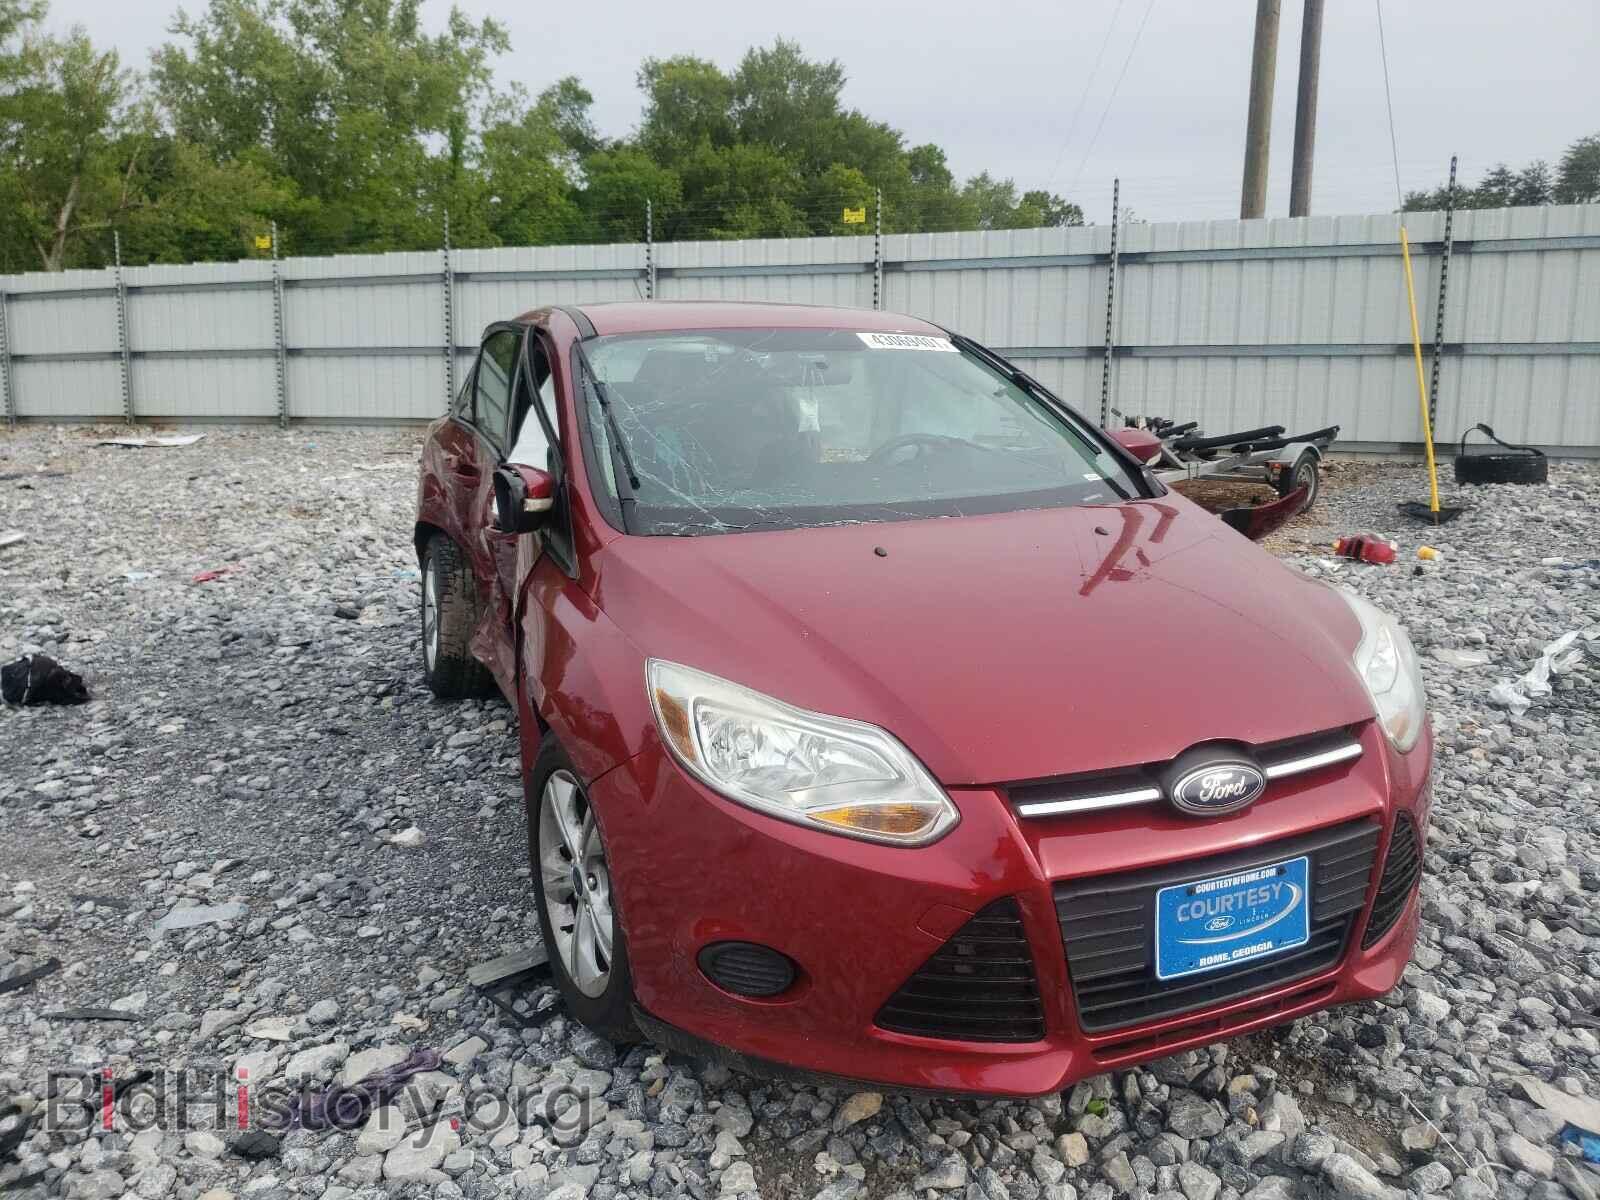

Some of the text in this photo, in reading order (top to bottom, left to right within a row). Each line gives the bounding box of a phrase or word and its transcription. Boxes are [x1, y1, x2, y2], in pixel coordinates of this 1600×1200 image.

[1199, 772, 1247, 802] Ford
[1177, 881, 1283, 922] COURTESY
[1239, 913, 1269, 925] LINCOLN
[1200, 952, 1231, 967] ROME,
[1232, 940, 1273, 958] GEORGIA
